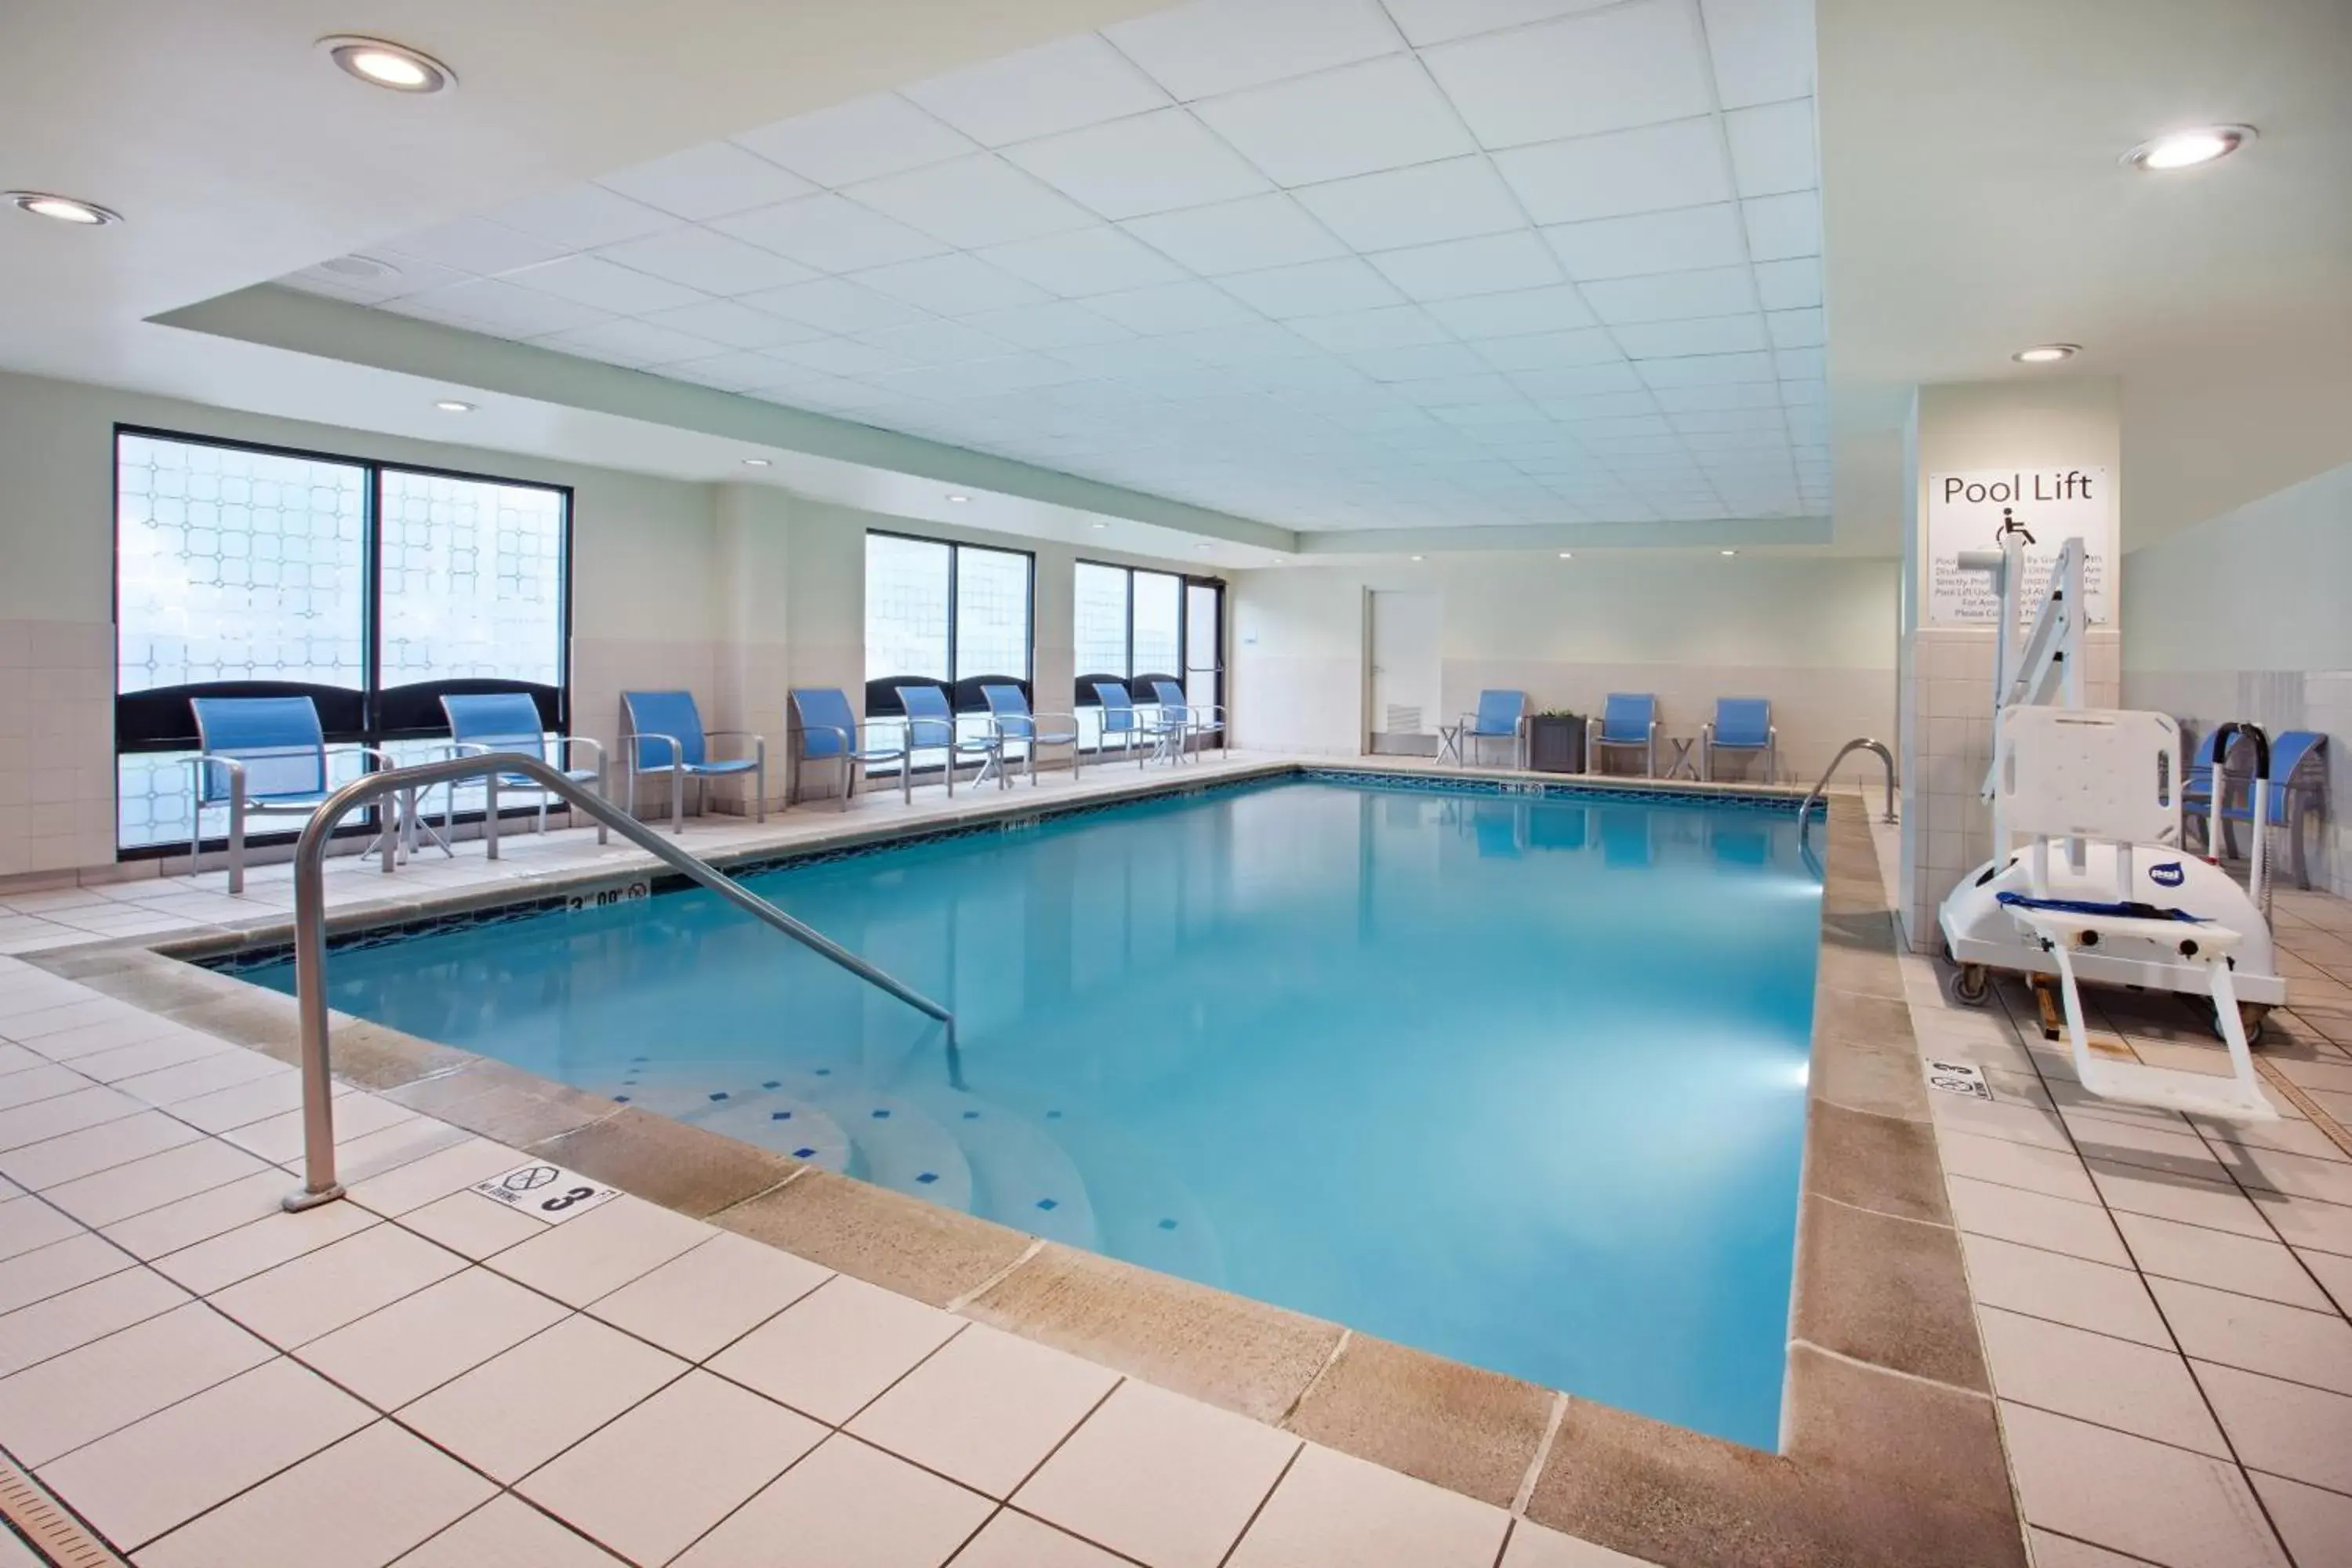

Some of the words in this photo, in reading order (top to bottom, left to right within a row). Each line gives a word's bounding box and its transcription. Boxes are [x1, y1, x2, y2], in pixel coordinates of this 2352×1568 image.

[1945, 474, 2019, 503] Pool
[2034, 470, 2092, 500] Lift
[541, 1186, 595, 1211] 3
